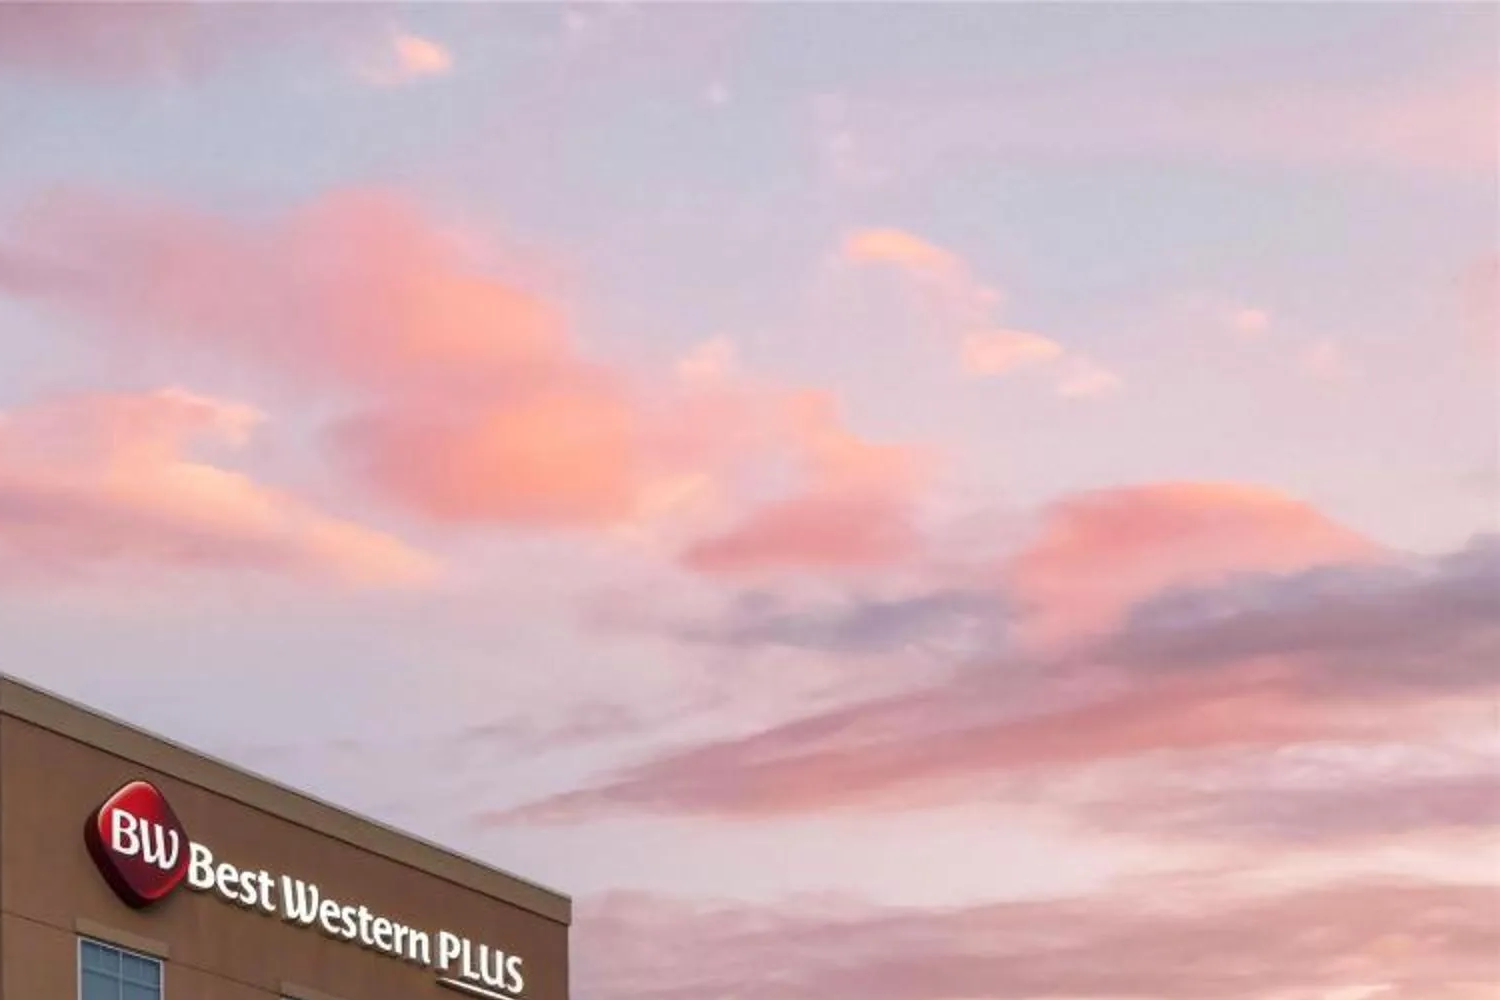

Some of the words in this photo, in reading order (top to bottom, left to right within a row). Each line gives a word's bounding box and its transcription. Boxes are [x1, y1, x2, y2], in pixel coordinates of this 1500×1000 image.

[112, 808, 179, 869] BW
[188, 841, 276, 911] Best
[281, 874, 430, 964] Western
[439, 931, 524, 993] PLUS
